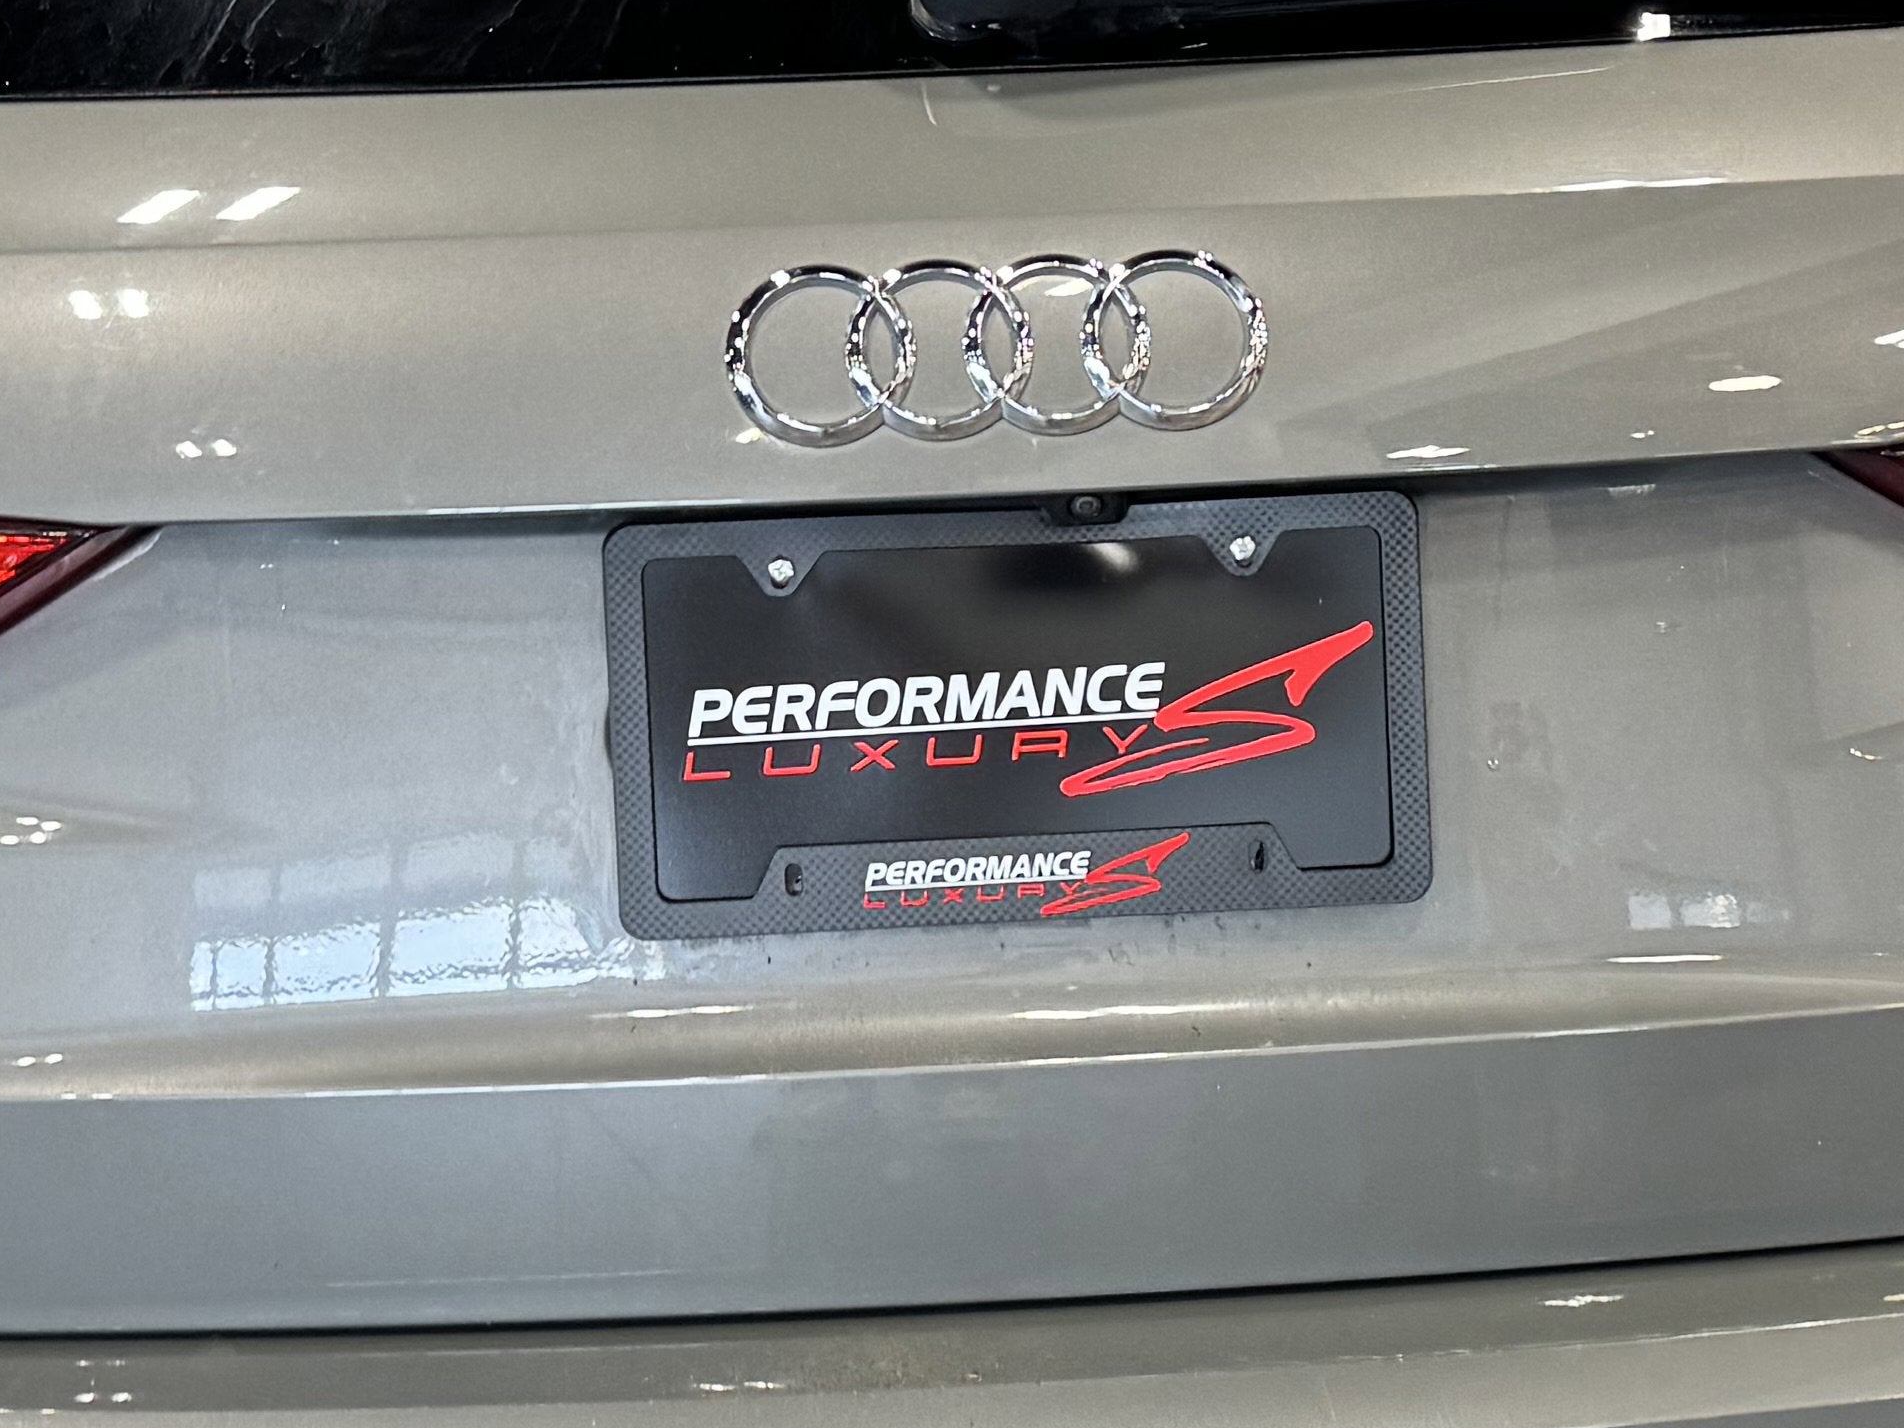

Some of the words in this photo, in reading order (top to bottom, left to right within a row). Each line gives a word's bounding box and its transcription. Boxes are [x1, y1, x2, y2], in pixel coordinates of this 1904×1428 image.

[688, 662, 1165, 738] PERFORMANCE
[683, 723, 1148, 781] LUXURY
[865, 850, 1093, 887] PERFORMANCE
[863, 881, 1087, 910] LUXURY
